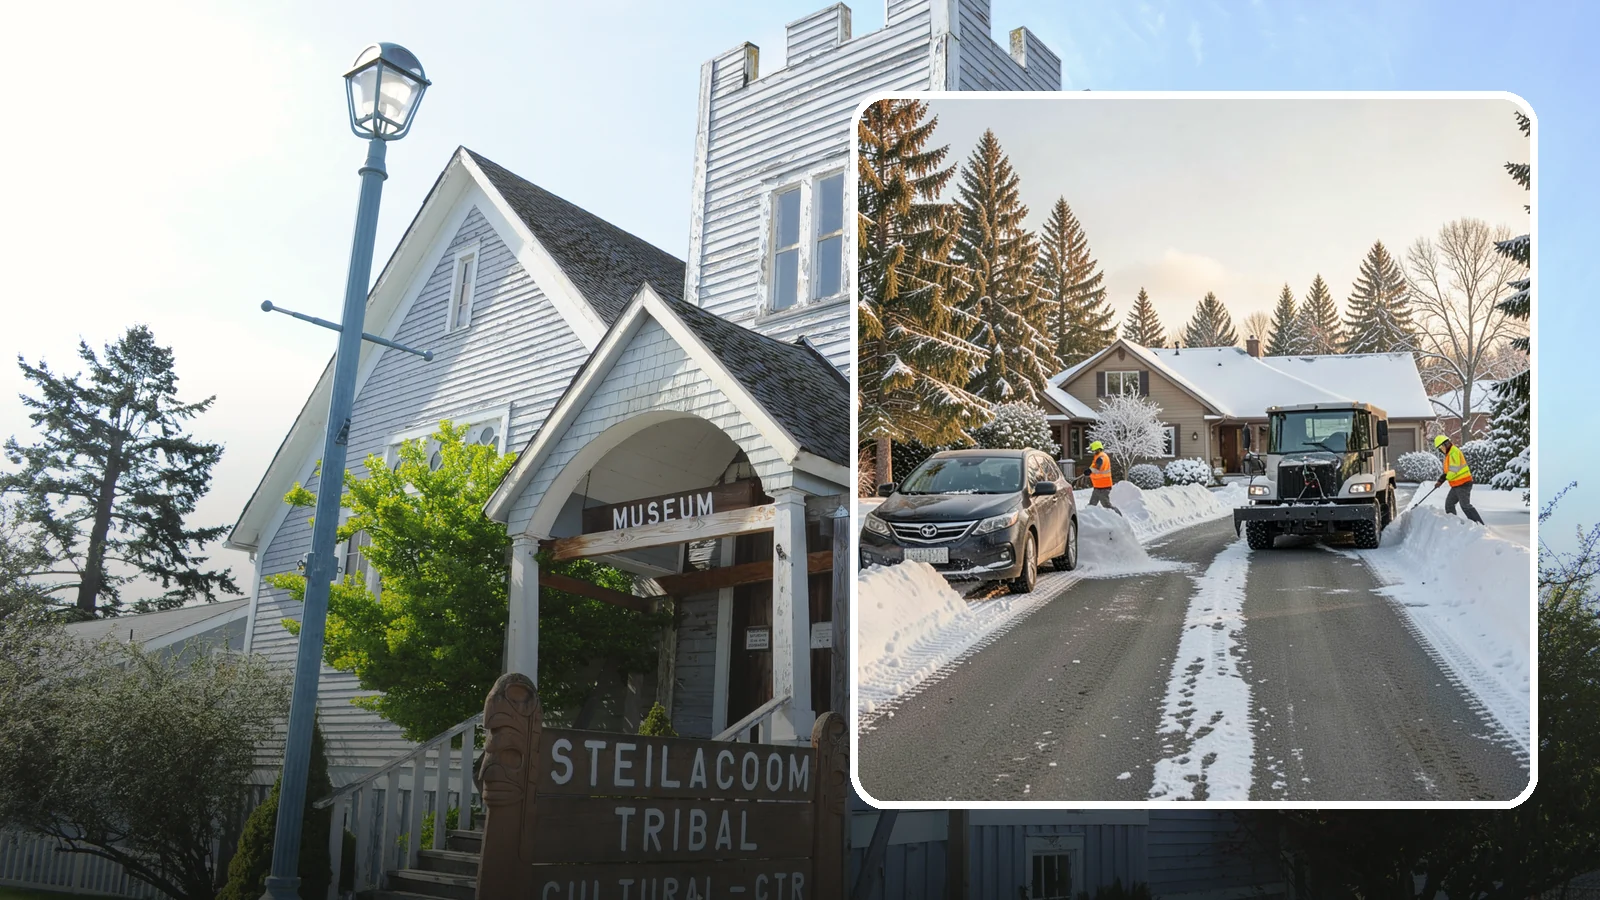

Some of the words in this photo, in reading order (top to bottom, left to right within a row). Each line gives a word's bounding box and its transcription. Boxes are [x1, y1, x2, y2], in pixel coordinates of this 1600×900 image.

[613, 492, 713, 530] MUSEUM
[552, 738, 809, 792] STEILACOOM
[615, 807, 757, 851] TRIBAL
